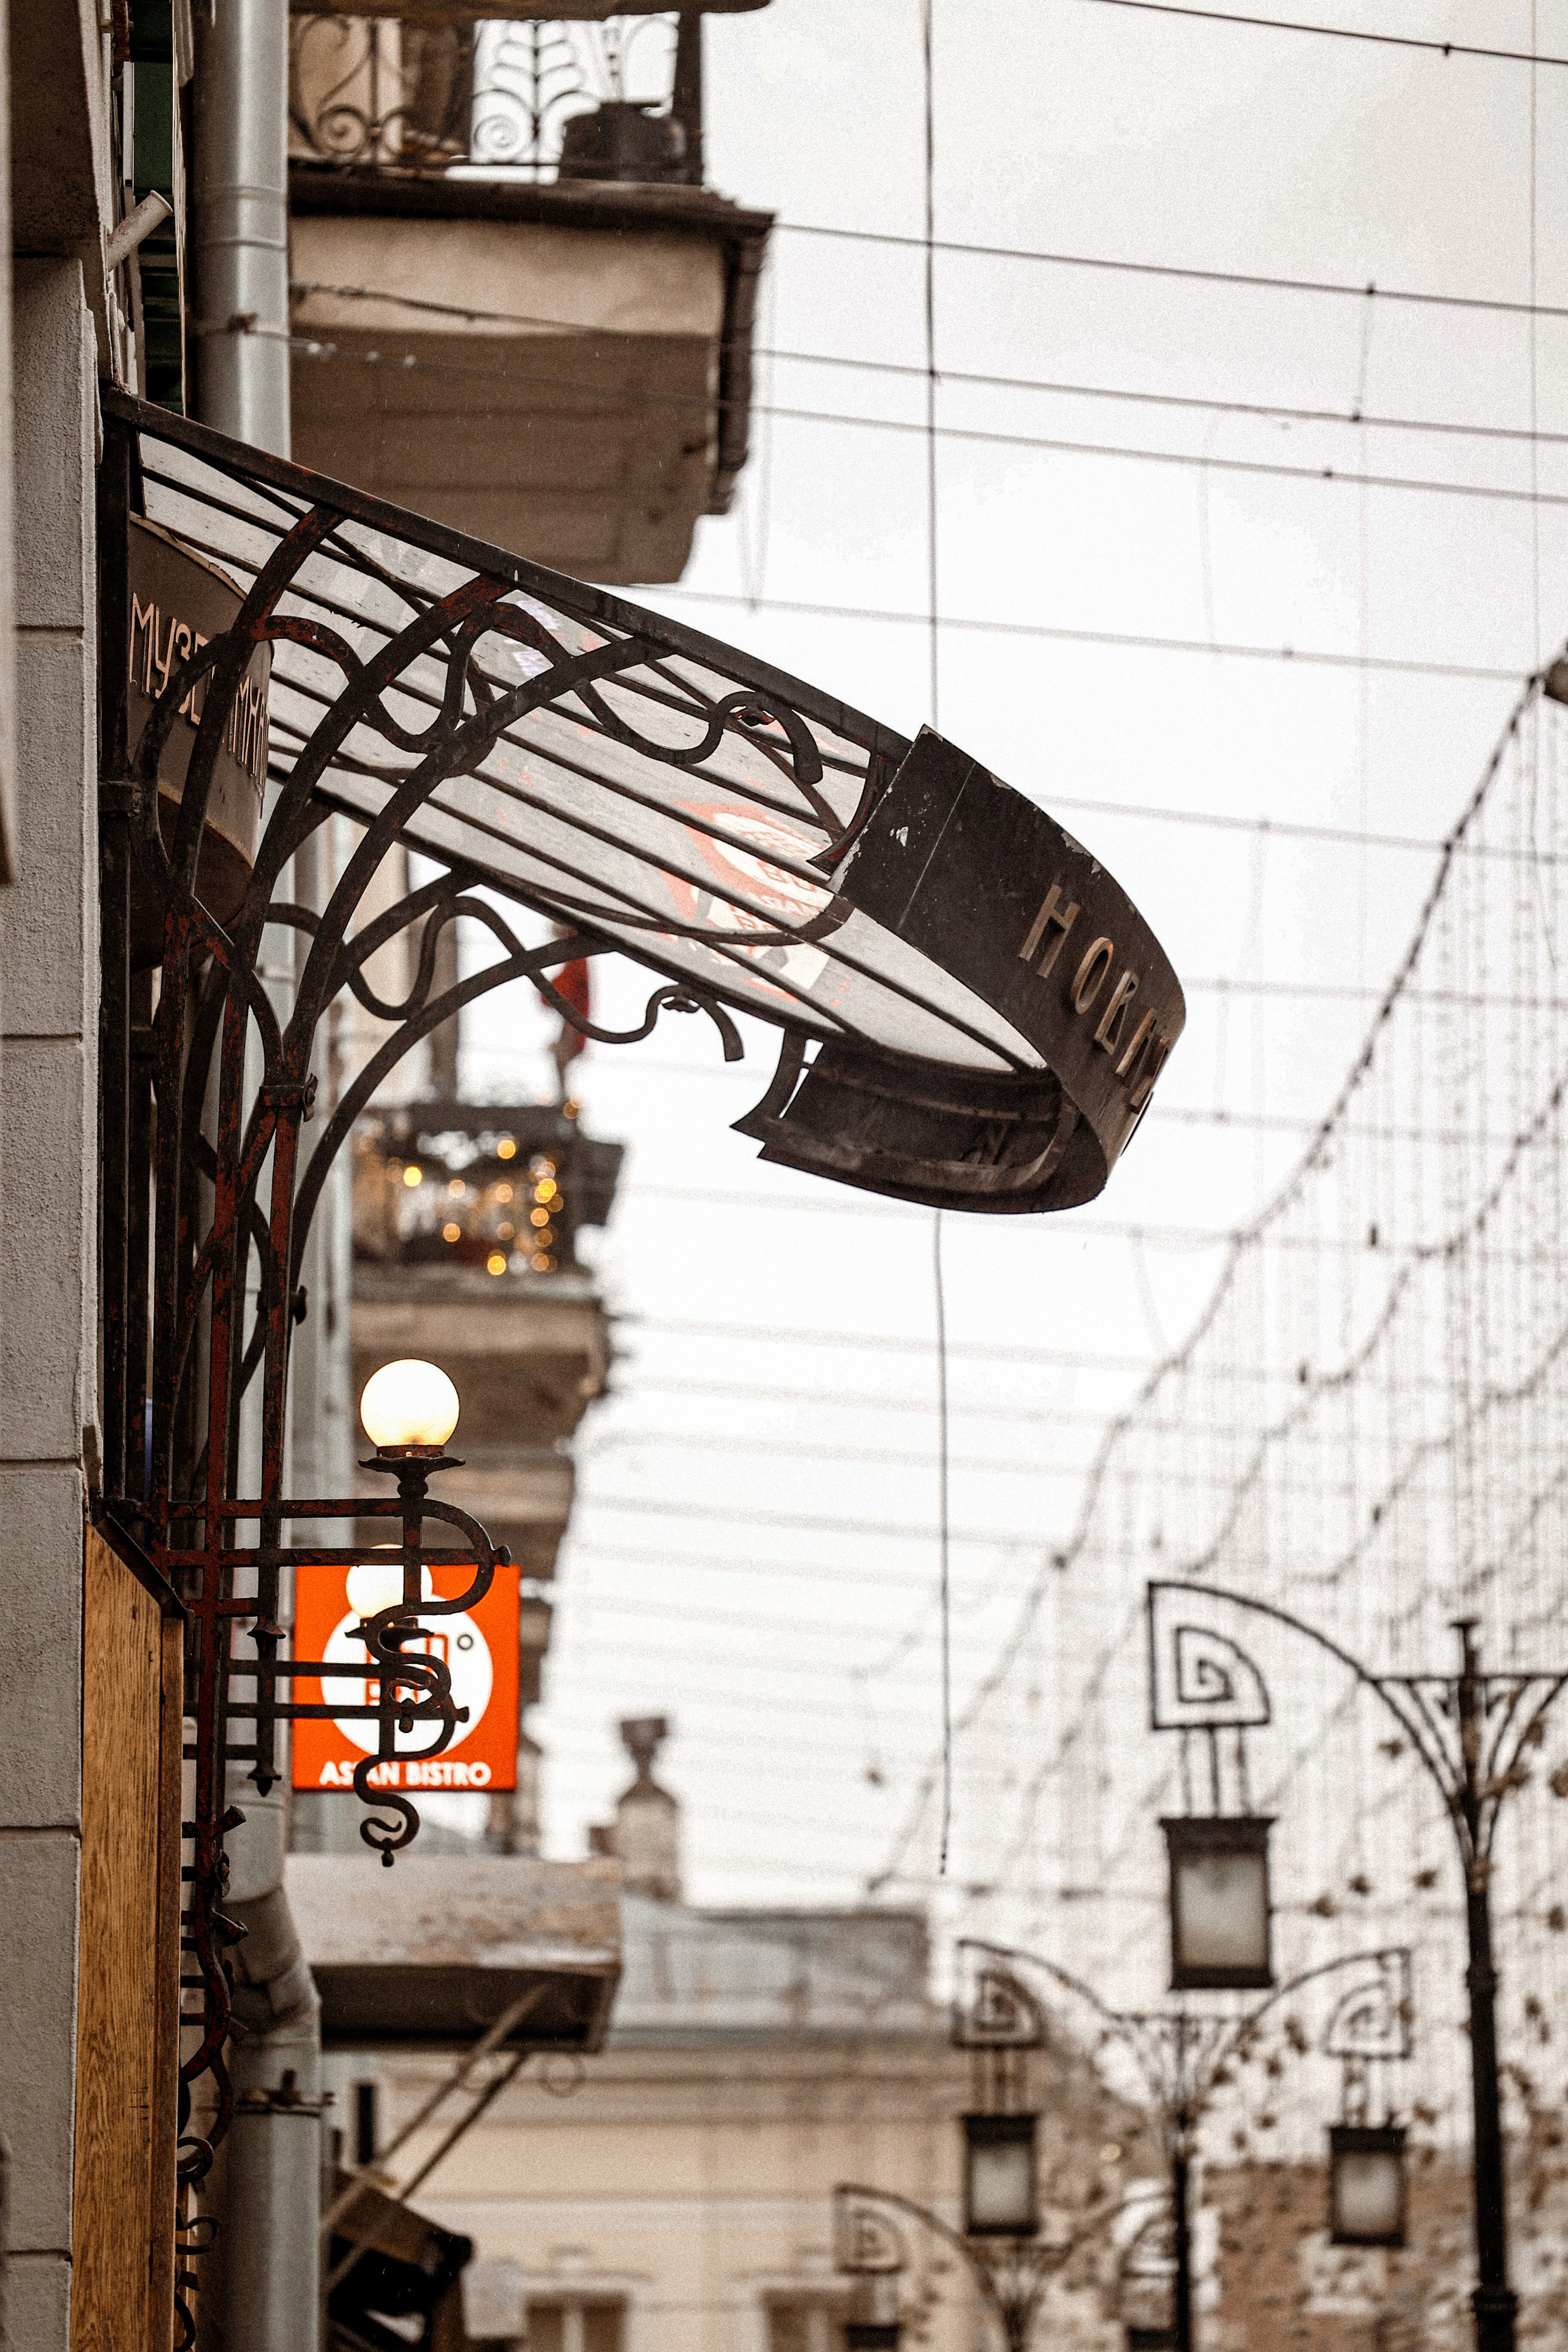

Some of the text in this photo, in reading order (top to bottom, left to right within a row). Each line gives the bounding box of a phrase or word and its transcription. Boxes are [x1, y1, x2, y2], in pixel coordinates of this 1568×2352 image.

[129, 592, 225, 743] МУЗЕ
[318, 1760, 492, 1786] ASAN BISTRO
